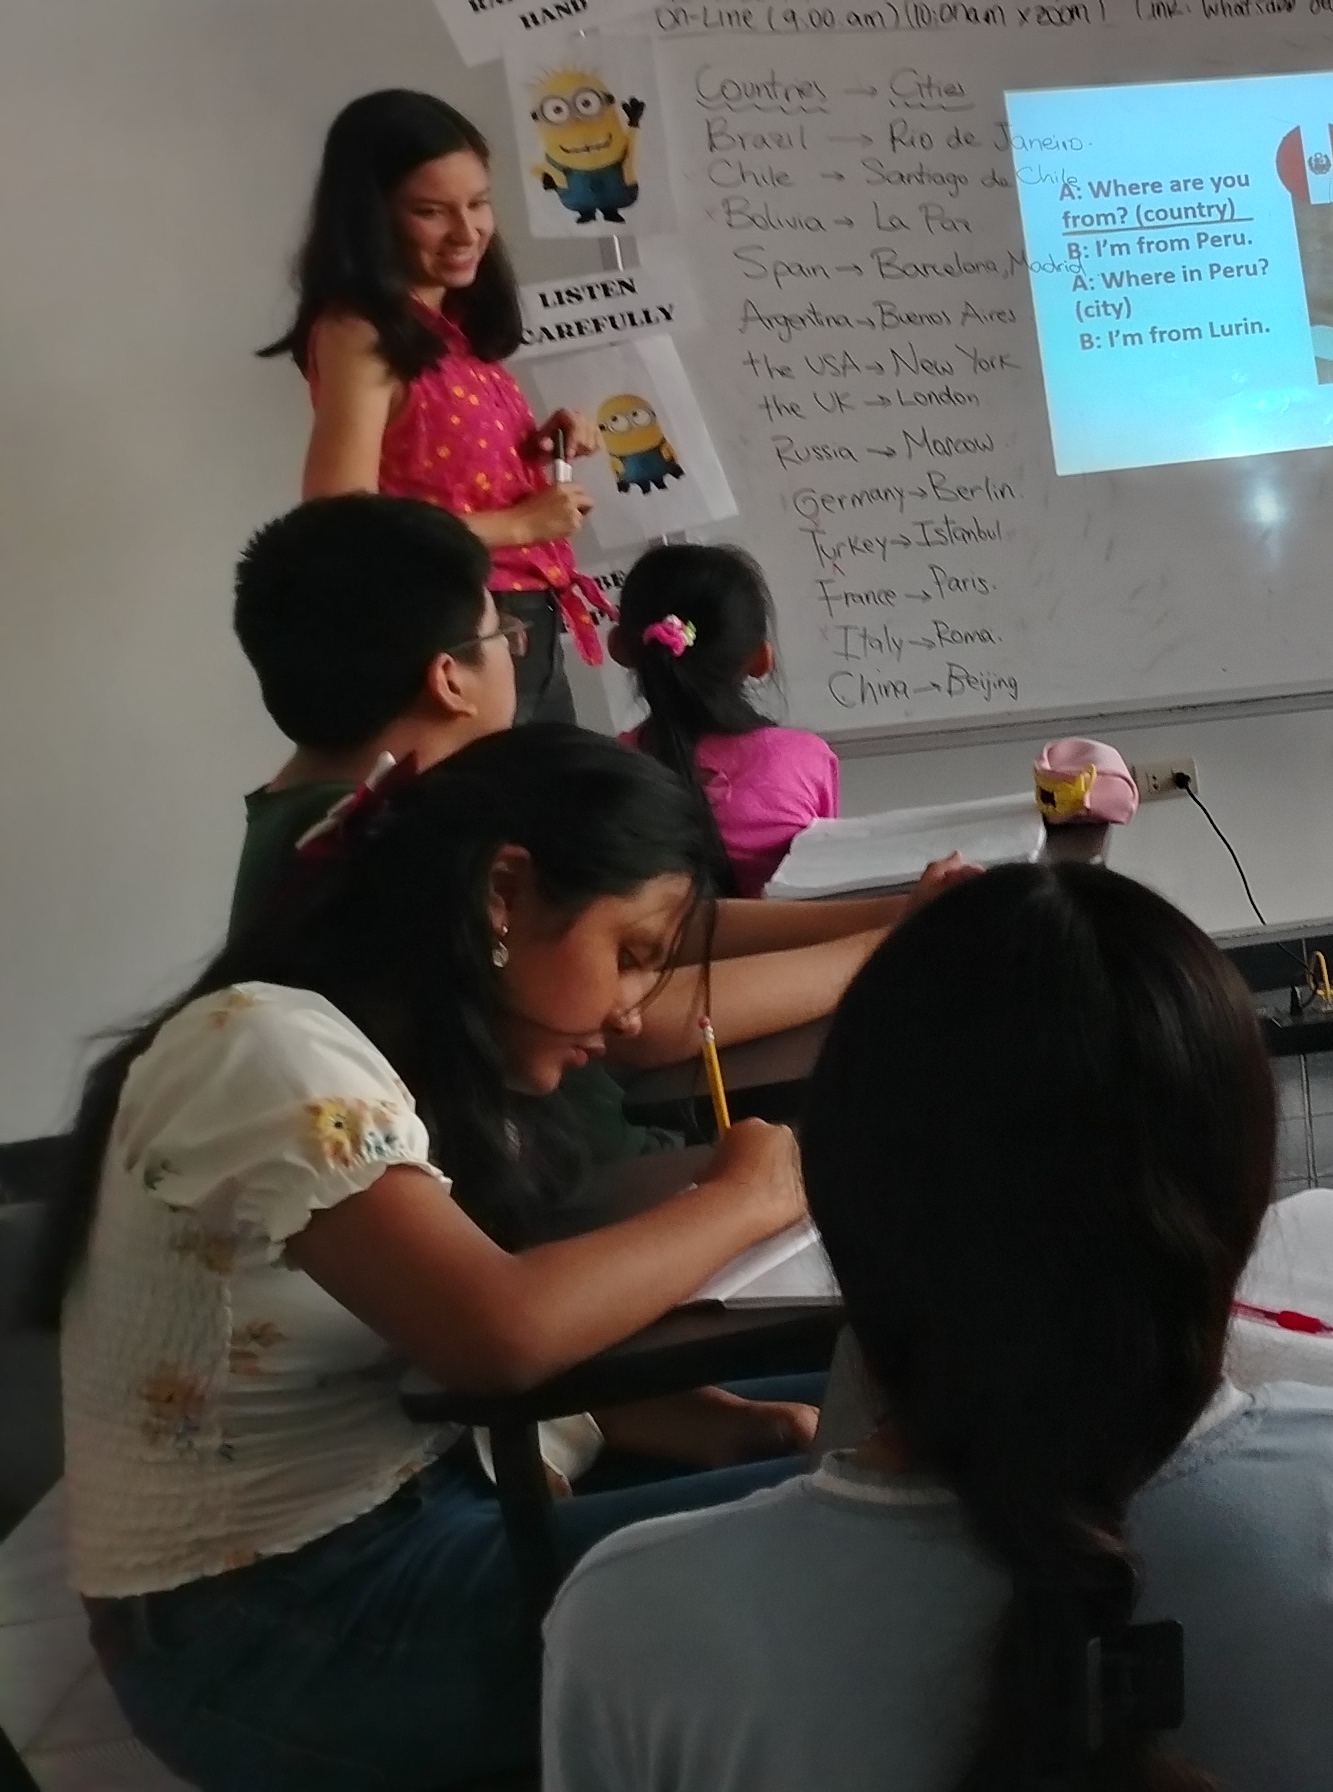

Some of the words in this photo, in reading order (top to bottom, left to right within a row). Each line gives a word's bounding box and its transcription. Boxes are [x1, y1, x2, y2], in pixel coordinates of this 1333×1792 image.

[696, 65, 829, 103] Countries
[889, 66, 966, 99] Cities
[706, 116, 809, 153] Brazil
[889, 117, 933, 153] Rio
[946, 124, 981, 151] de
[708, 160, 794, 188] Chile
[861, 157, 967, 197] Santiago
[1015, 164, 1079, 189] Chile
[1059, 183, 1083, 201] A:
[1088, 178, 1164, 199] Where
[1169, 176, 1205, 193] are
[1210, 173, 1251, 195] you
[720, 200, 827, 235] Bolivia
[874, 201, 913, 233] La
[1062, 206, 1129, 229] from?
[1136, 197, 1236, 229] (country)
[1067, 241, 1091, 261] B:
[1136, 235, 1191, 254] from
[1196, 230, 1253, 250] Peru.
[732, 245, 832, 289] Spain
[1007, 249, 1087, 278] Madrid
[1071, 273, 1096, 292] A:
[1100, 269, 1177, 290] Where
[1182, 265, 1203, 283] in
[1208, 257, 1270, 281] Peru?
[538, 277, 638, 309] LISTEN
[1075, 296, 1133, 323] (city)
[521, 303, 676, 346] CAREFULLY
[739, 298, 855, 343] Argentina
[872, 300, 953, 330] Buenos
[960, 300, 1018, 327] Aires
[1079, 332, 1102, 351] B:
[1149, 325, 1203, 345] from
[1208, 317, 1271, 339] Lurin.
[742, 350, 797, 381] the
[804, 350, 863, 379] USA
[889, 342, 955, 378] New
[954, 343, 1023, 377] York
[758, 392, 806, 423] the
[812, 390, 857, 415] UK
[897, 384, 981, 409] London
[770, 434, 860, 471] Russia
[792, 485, 905, 523] Germany
[799, 526, 890, 569] Turkey
[814, 578, 897, 619] France
[832, 623, 905, 662] Italy
[828, 668, 911, 709] China
[945, 661, 1020, 702] Beijing
